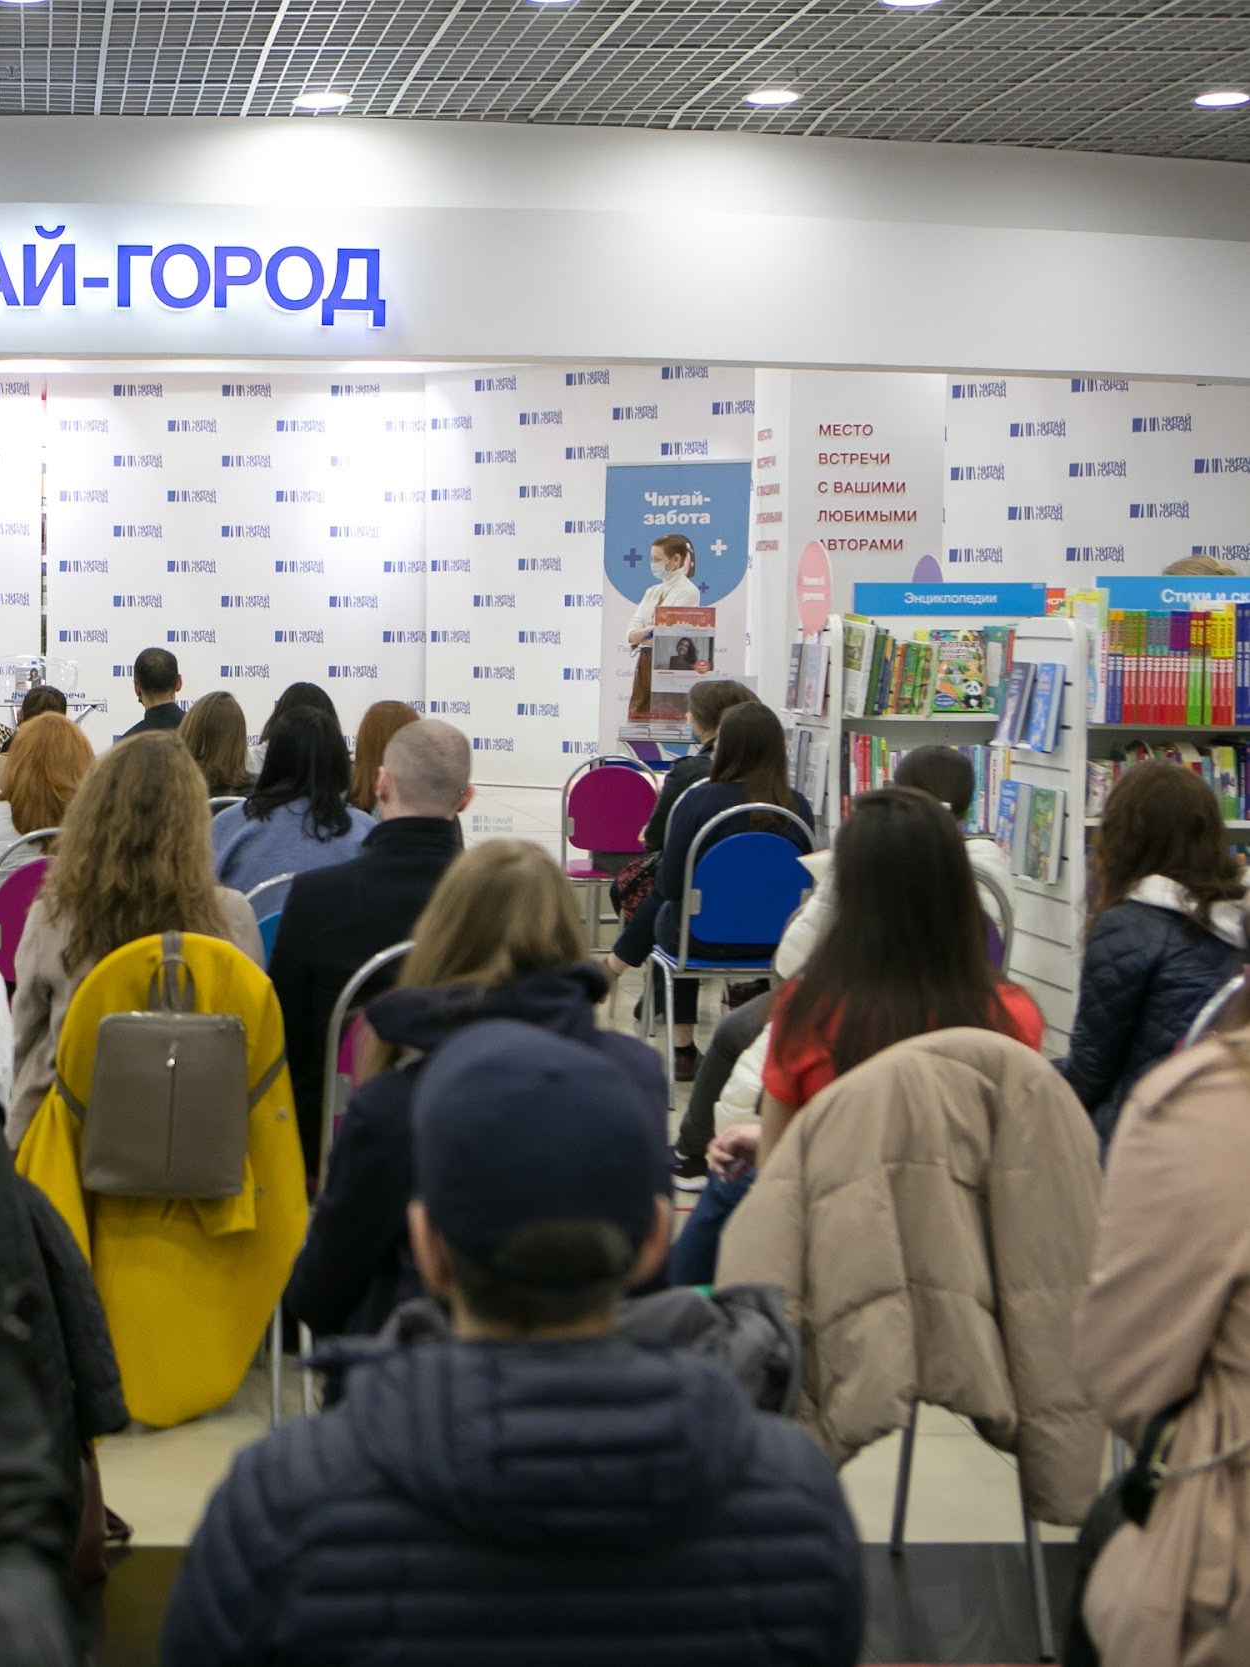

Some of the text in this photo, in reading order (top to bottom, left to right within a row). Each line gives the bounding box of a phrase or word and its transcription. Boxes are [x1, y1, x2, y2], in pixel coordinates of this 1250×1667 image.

[979, 380, 1006, 389] ЧИТАЙ
[979, 389, 1006, 398] ГОРОД
[1162, 414, 1192, 423] ЧИТАЙ
[1038, 420, 1066, 429] ЧИТАЙ
[1162, 423, 1192, 432] ГОРОД
[818, 424, 874, 437] МЕСТО
[1038, 428, 1066, 437] ГОРОД
[818, 452, 890, 466] ВСТРЕЧИ
[1097, 459, 1126, 468] ЧИТАЙ
[977, 463, 1004, 472] ЧИТАЙ
[977, 472, 1004, 481] ГОРОД
[1097, 468, 1126, 477] ГОРОД
[817, 481, 906, 494] С ВАШИМИ
[644, 491, 711, 507] Читай-
[1035, 503, 1063, 512] ЧИТАЙ
[1159, 501, 1189, 510] ЧИТАЙ
[643, 509, 711, 526] забота
[817, 510, 917, 523] ЛЮБИМЫМИ
[1035, 512, 1063, 521] ГОРОД
[1159, 510, 1189, 519] ГОРОД
[976, 547, 1003, 555] ЧИТАЙ
[1095, 545, 1124, 554] ЧИТАЙ
[976, 555, 1003, 563] ГОРОД
[1095, 553, 1124, 562] ГОРОД
[904, 592, 998, 606] Энциклопедии
[1161, 588, 1212, 603] Стихи
